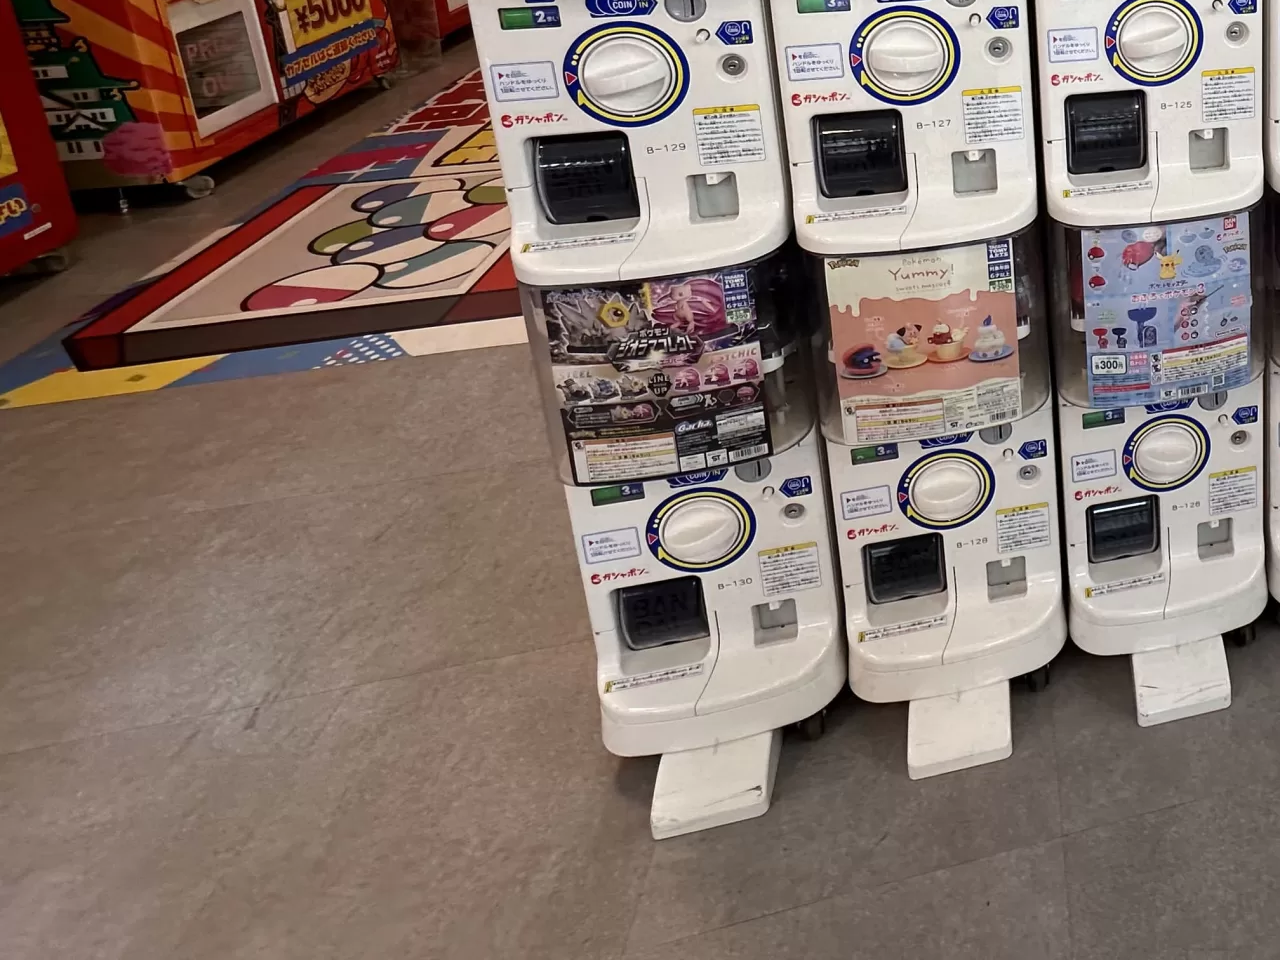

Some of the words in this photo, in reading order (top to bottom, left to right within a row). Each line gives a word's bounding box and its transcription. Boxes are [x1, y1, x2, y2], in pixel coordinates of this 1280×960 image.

[612, 0, 633, 10] COIN
[638, 0, 649, 8] IN
[1062, 73, 1100, 84] ガシャポン
[803, 92, 846, 104] ガシャポン
[1161, 101, 1192, 110] B-125
[513, 113, 564, 125] ガシャポン
[916, 119, 951, 130] B-127
[646, 143, 686, 155] B-129
[902, 256, 942, 265] Pokémon
[889, 267, 948, 281] Yummy
[638, 327, 669, 336] ポケモン
[650, 374, 670, 383] LINE
[654, 386, 668, 395] UP
[1084, 486, 1119, 497] ガシャポン
[858, 525, 896, 536] ガシャポン
[957, 537, 988, 548] B-128
[603, 568, 646, 581] ガシャポン
[717, 578, 753, 590] B-130
